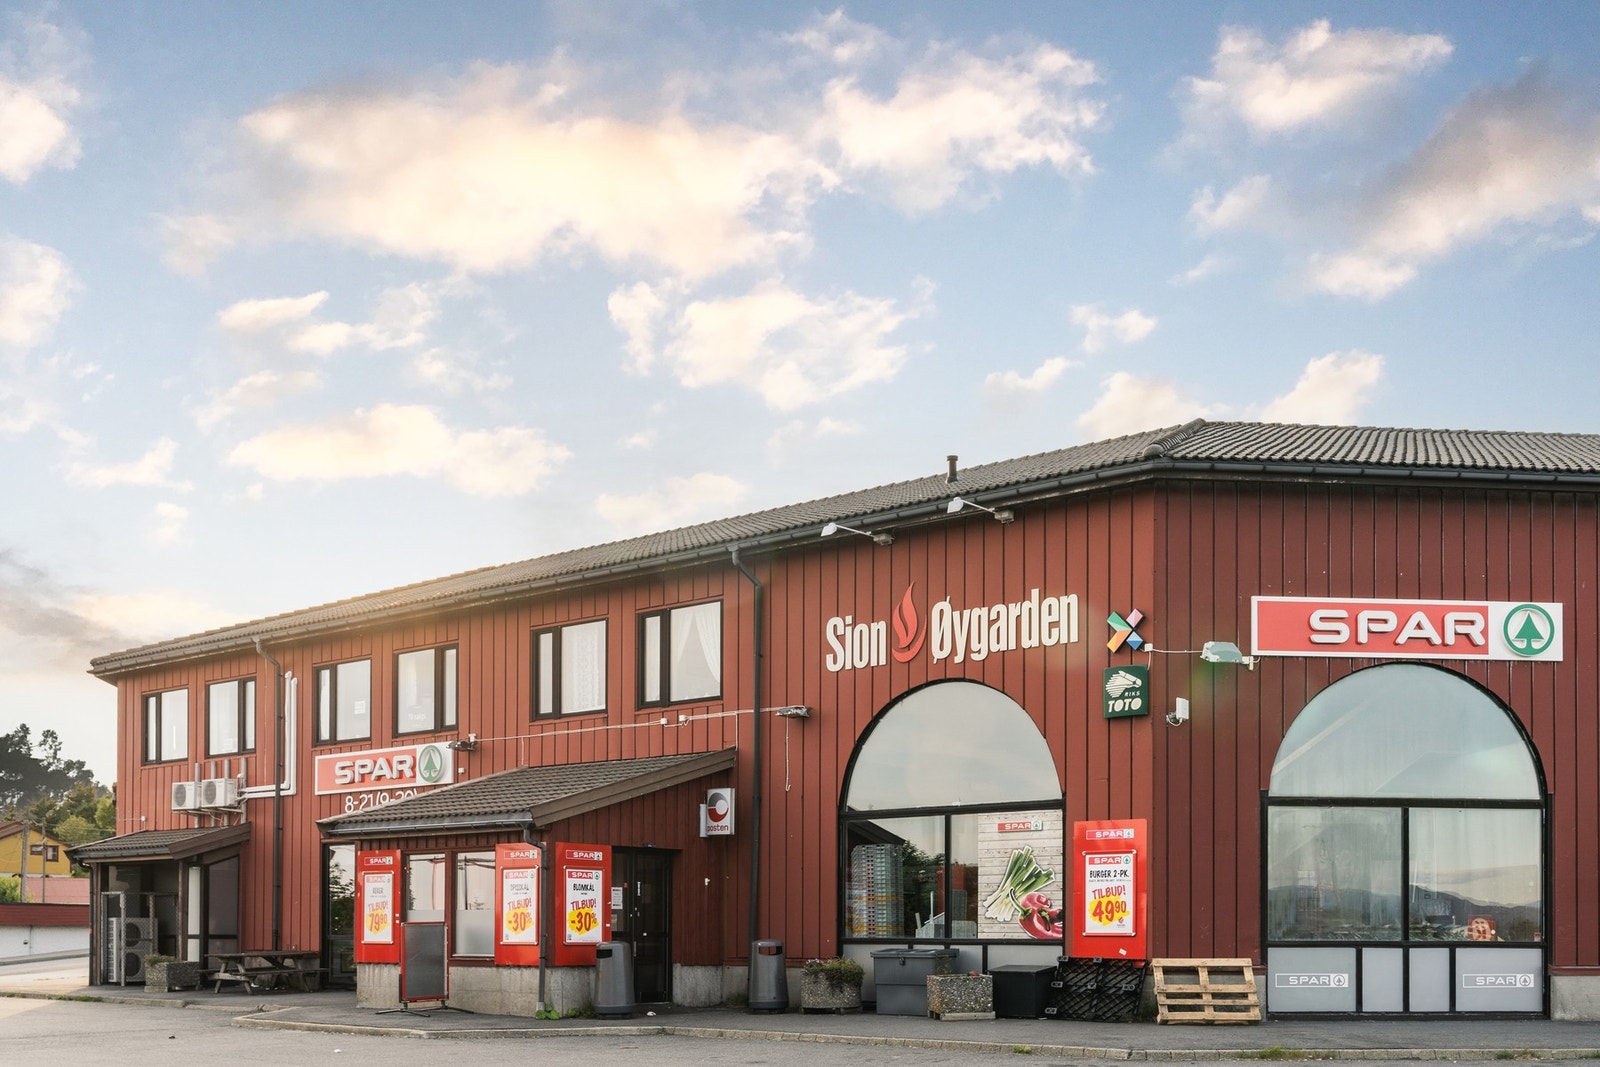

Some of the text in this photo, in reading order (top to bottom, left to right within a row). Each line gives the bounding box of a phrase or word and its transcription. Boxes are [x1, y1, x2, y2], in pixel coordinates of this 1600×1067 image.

[826, 588, 1079, 672] Sion Øygarden
[1309, 609, 1485, 646] SPAR
[1108, 697, 1142, 712] TOTO
[334, 755, 414, 785] SPAR
[1004, 822, 1031, 830] SPAR
[1095, 830, 1124, 838] SPAR
[1093, 856, 1121, 864] SPAR
[508, 871, 528, 879] SPAR
[1089, 870, 1112, 878] BURGER
[573, 882, 595, 892] BLOMKÅL
[1091, 885, 1126, 899] TILBUD!
[507, 898, 532, 911] TILBUD!
[570, 898, 597, 910] TILBUD!
[508, 912, 533, 932] -30%
[571, 911, 597, 932] -30%
[1288, 976, 1329, 985] SPAR
[1475, 976, 1516, 985] SPAR
